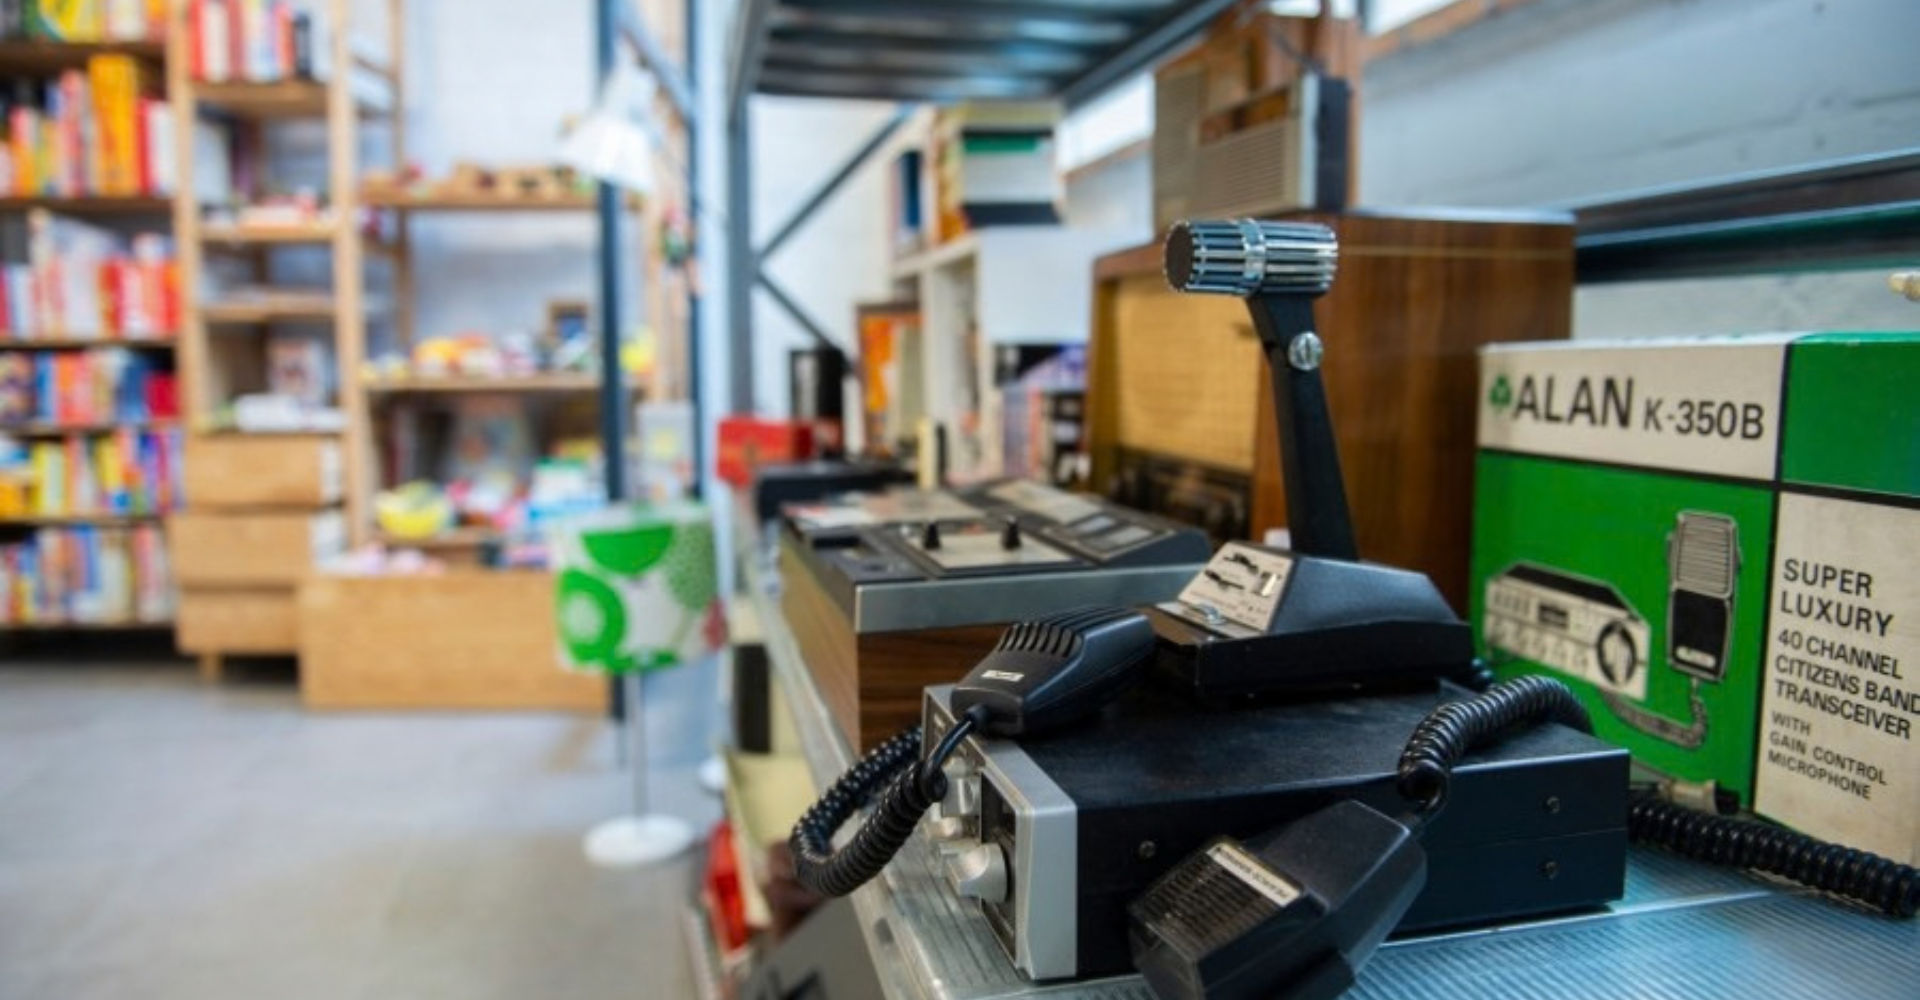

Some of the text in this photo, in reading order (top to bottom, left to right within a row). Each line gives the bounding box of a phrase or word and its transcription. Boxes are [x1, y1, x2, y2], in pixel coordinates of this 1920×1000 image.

[1514, 375, 1765, 440] ALAN K-350B
[1783, 558, 1873, 598] SUPER
[1780, 590, 1894, 638] LUXURY
[1778, 629, 1904, 680] 40 CHANNEL
[1775, 654, 1920, 716] CITIZENS BAND
[1775, 678, 1912, 740] TRANSCEIVER
[1771, 710, 1811, 737] WITH
[1767, 749, 1872, 800] MICROPHONE
[1769, 731, 1888, 786] GAIN CONTROL
